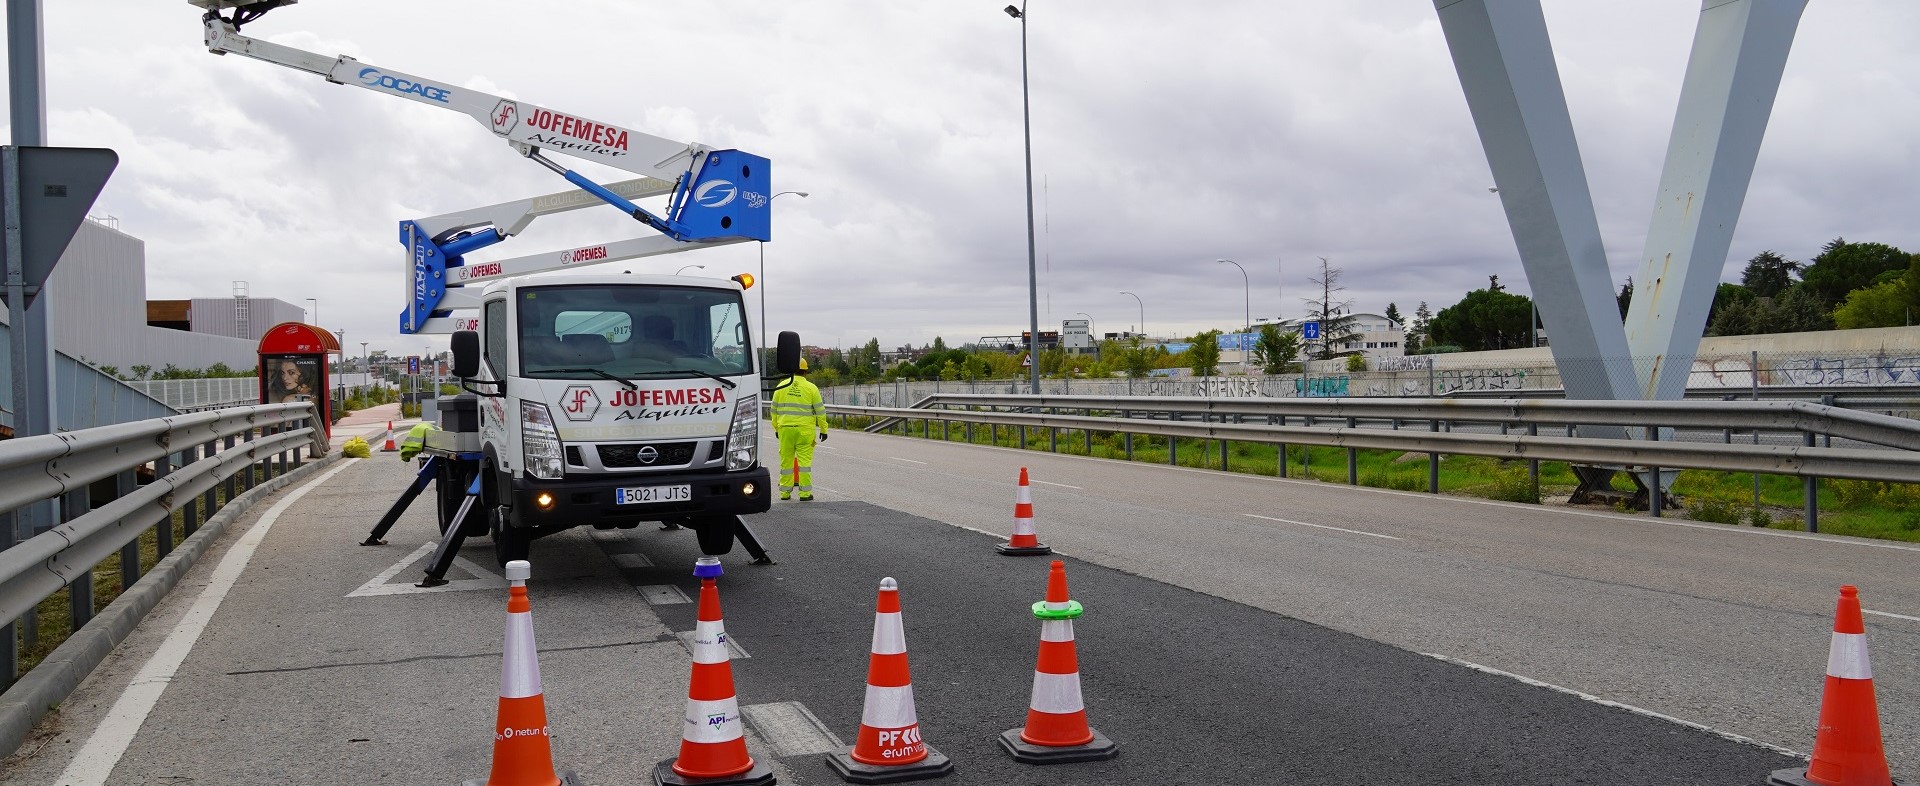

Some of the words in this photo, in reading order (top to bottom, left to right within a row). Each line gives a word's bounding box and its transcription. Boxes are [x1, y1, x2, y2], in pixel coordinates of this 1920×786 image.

[527, 108, 628, 151] JOFEMESA
[528, 133, 627, 156] Alquiler
[537, 192, 588, 208] ALQUILER
[612, 179, 673, 196] CONDUCTO
[572, 246, 608, 263] JOFEMESA
[469, 263, 502, 278] JOFEMESA
[610, 387, 726, 407] JOFEMESA
[614, 405, 727, 422] Alquiler
[574, 427, 603, 438] SIN
[608, 423, 719, 438] CONDUCTOR
[626, 488, 657, 502] 5021
[665, 486, 689, 500] JTS
[709, 716, 725, 725] API
[515, 728, 540, 736] netun
[878, 731, 902, 746] PF
